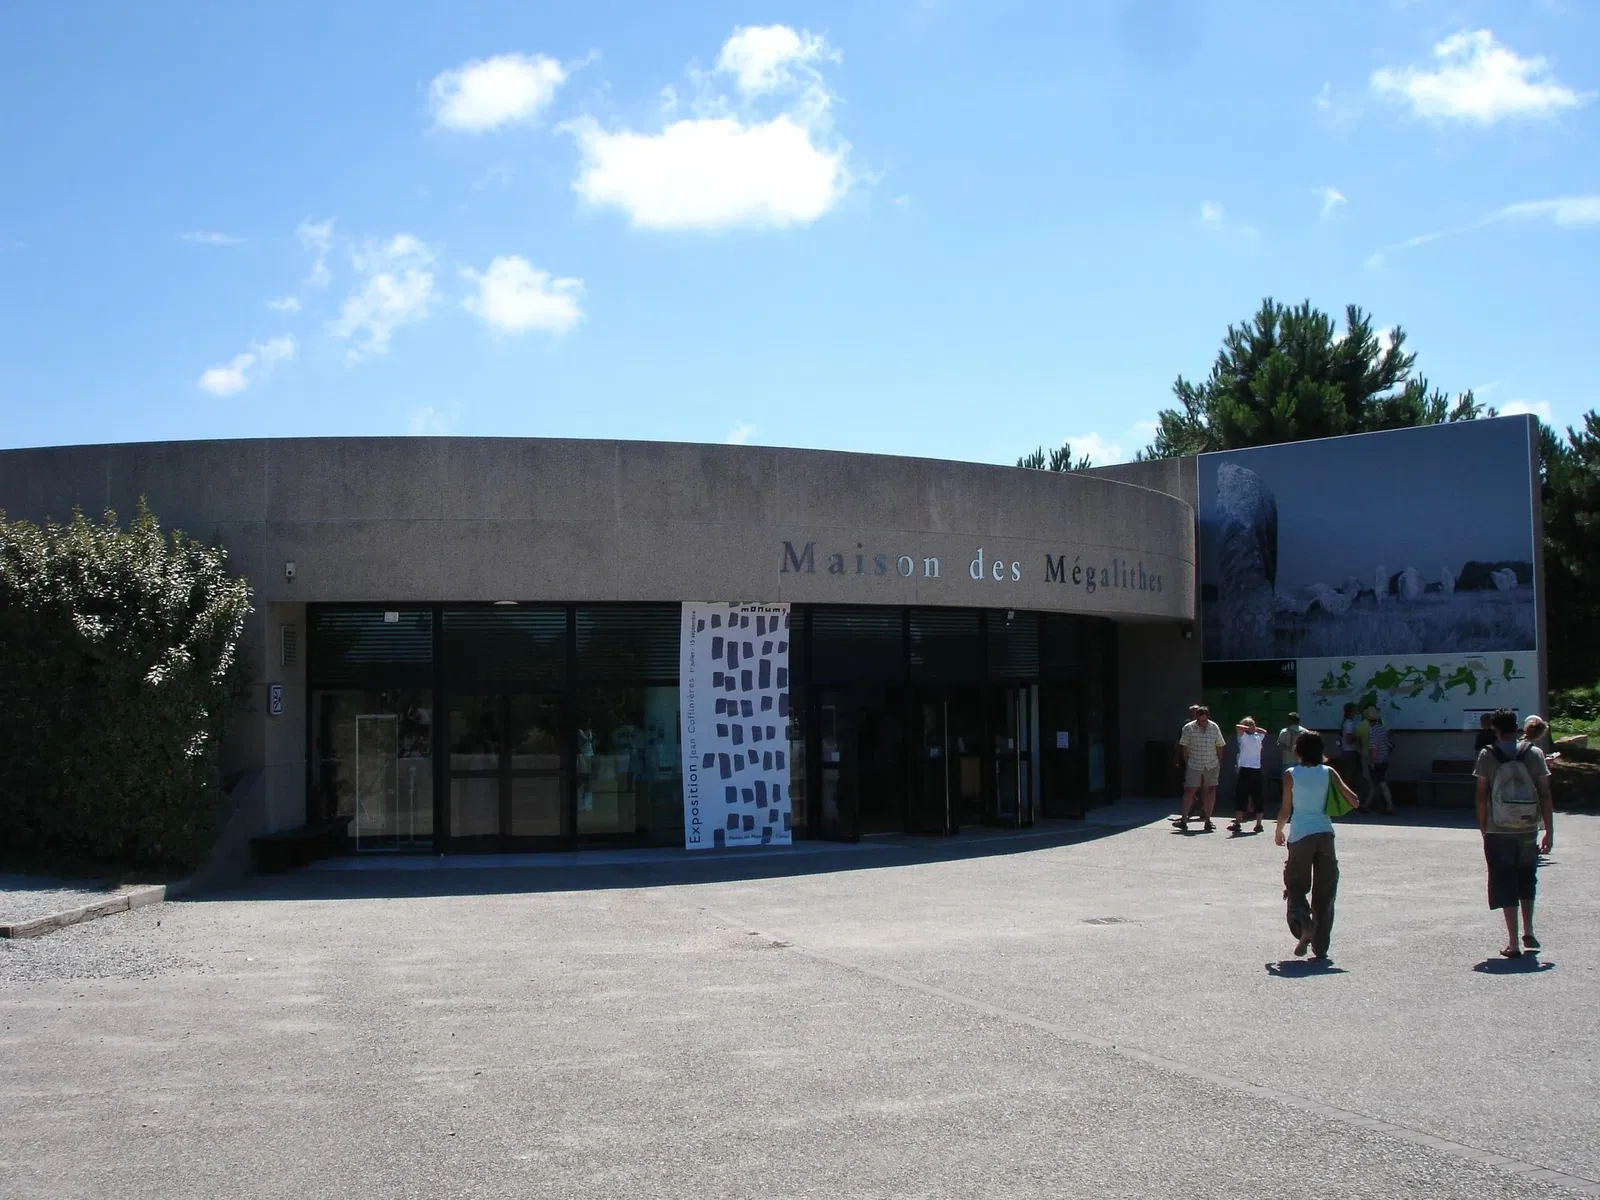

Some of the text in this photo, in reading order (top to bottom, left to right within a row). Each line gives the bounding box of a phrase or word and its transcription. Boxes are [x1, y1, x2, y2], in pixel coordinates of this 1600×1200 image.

[780, 541, 1163, 594] Maison des Mégalithes
[687, 678, 696, 734] Coffinières
[688, 764, 703, 843] Exposition
